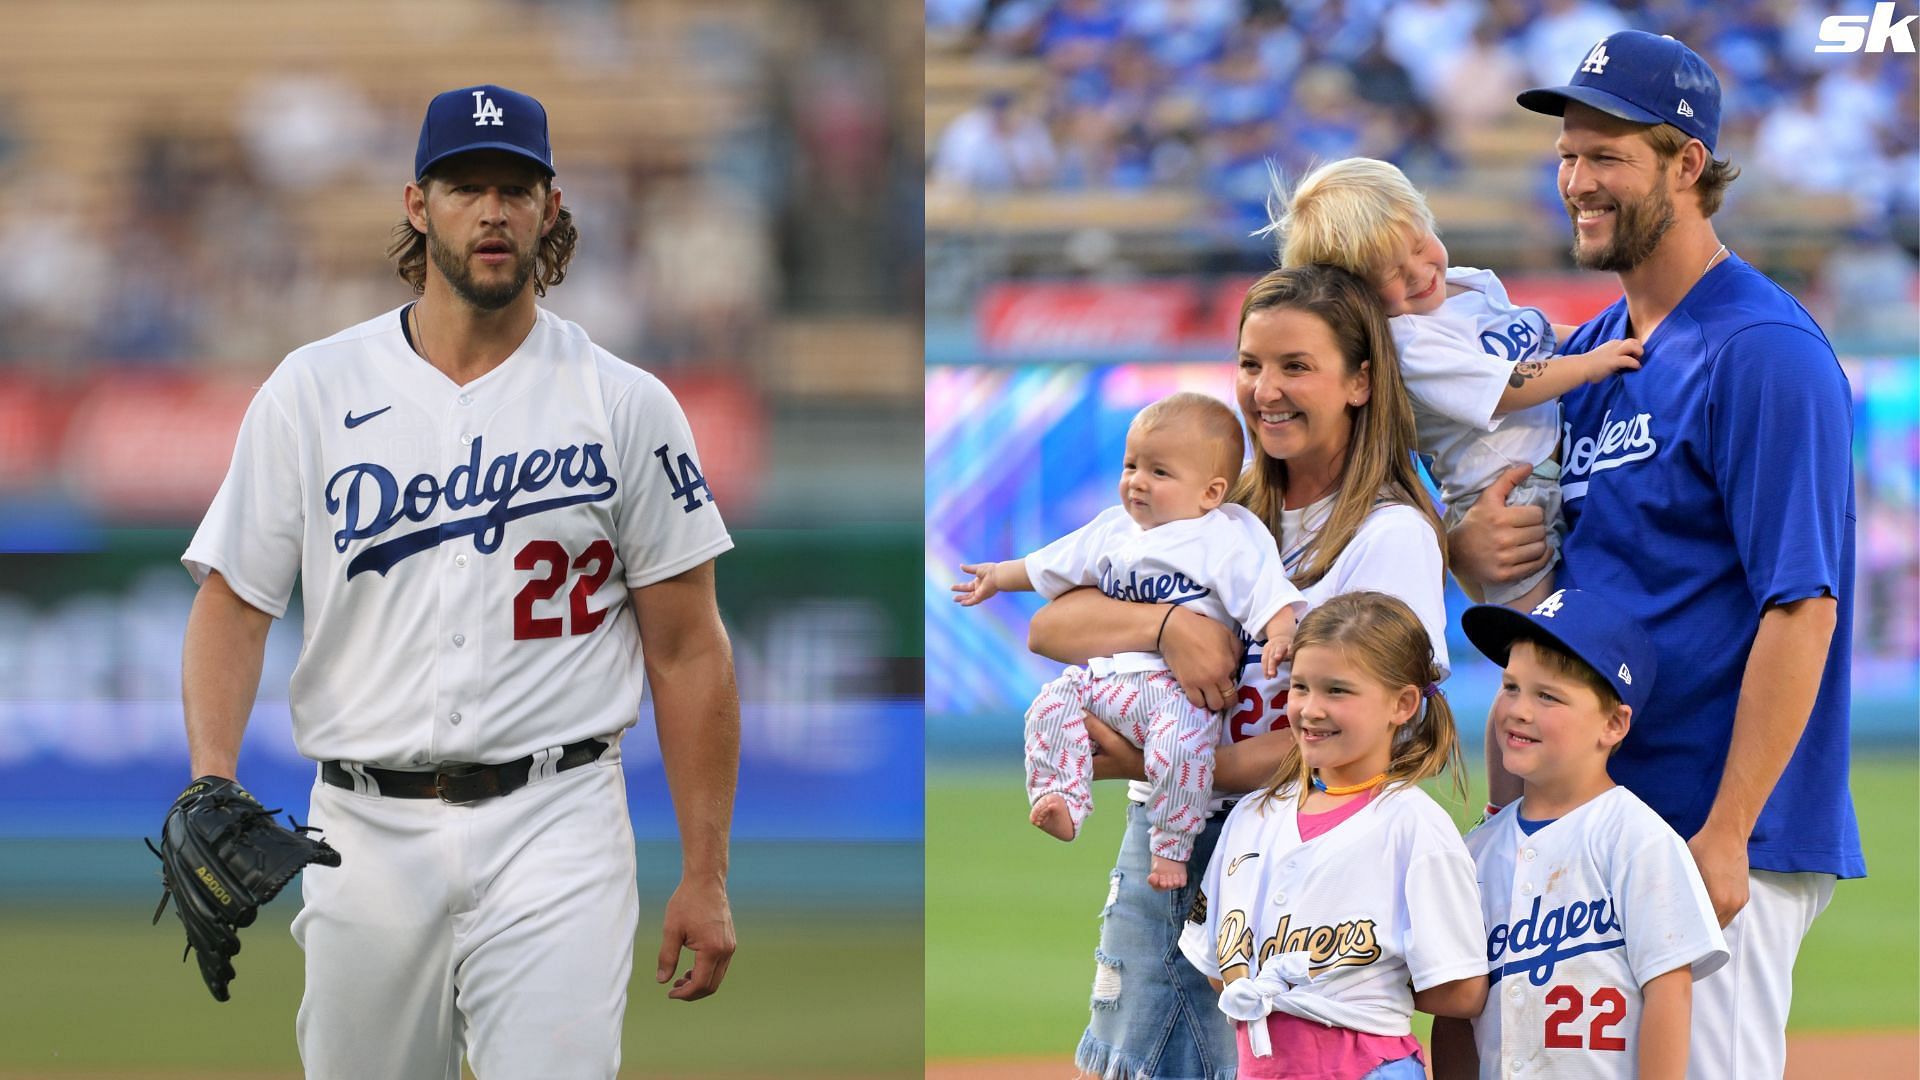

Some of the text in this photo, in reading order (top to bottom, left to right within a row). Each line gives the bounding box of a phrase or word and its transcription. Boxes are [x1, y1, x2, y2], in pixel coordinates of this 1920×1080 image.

[472, 90, 504, 126] LA
[325, 435, 617, 556] Dodgers
[653, 443, 714, 514] LA
[514, 539, 615, 641] 22
[194, 866, 232, 906] A2000
[1485, 895, 1622, 987] odger
[1544, 984, 1627, 1052] 22
